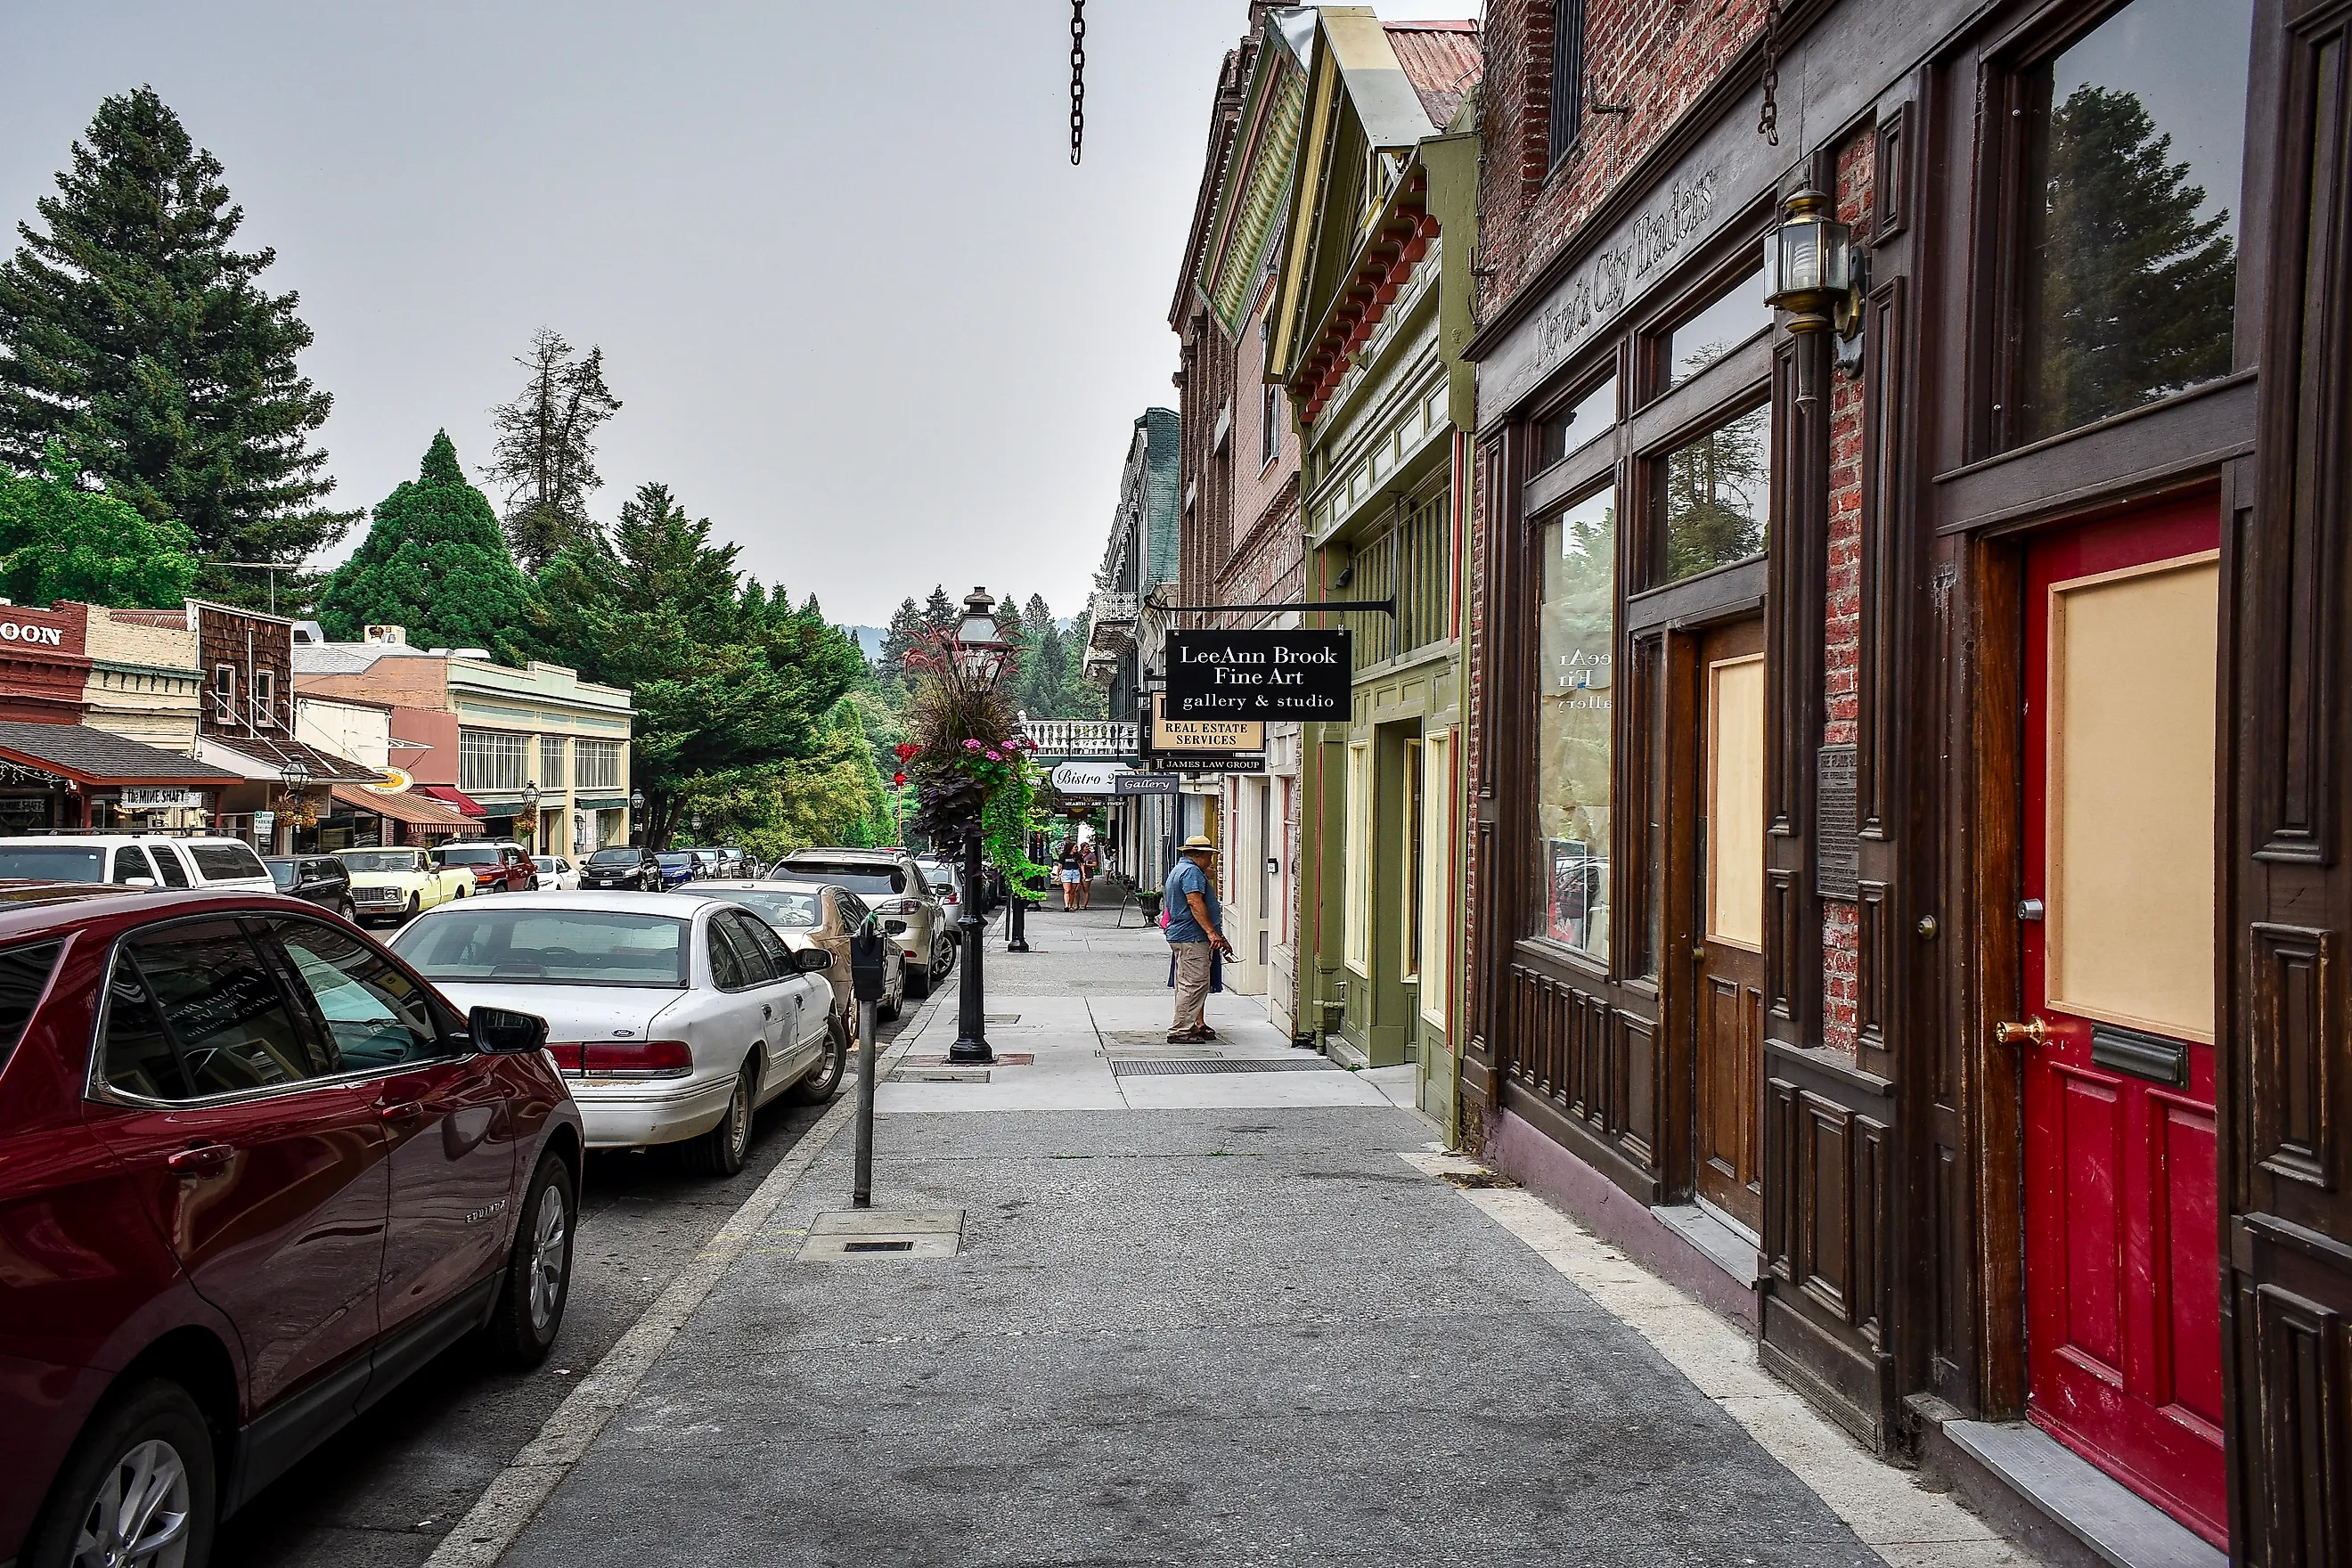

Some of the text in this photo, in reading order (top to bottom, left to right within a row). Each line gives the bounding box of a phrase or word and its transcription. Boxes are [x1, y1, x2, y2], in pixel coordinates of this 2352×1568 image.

[1536, 169, 1714, 365] Nevada City Traders
[1180, 646, 1338, 664] LeeAnn Brook
[1213, 667, 1304, 685] Fine Art
[1183, 694, 1335, 711] gallery & studio
[1164, 723, 1248, 733] REAL ESTATE
[1176, 735, 1237, 745] SERVICES
[1166, 761, 1200, 769] JAMES
[1226, 761, 1260, 769] GROUP
[1057, 768, 1101, 785] Bistro
[1124, 779, 1171, 790] Gallery
[161, 789, 186, 803] SHAFT
